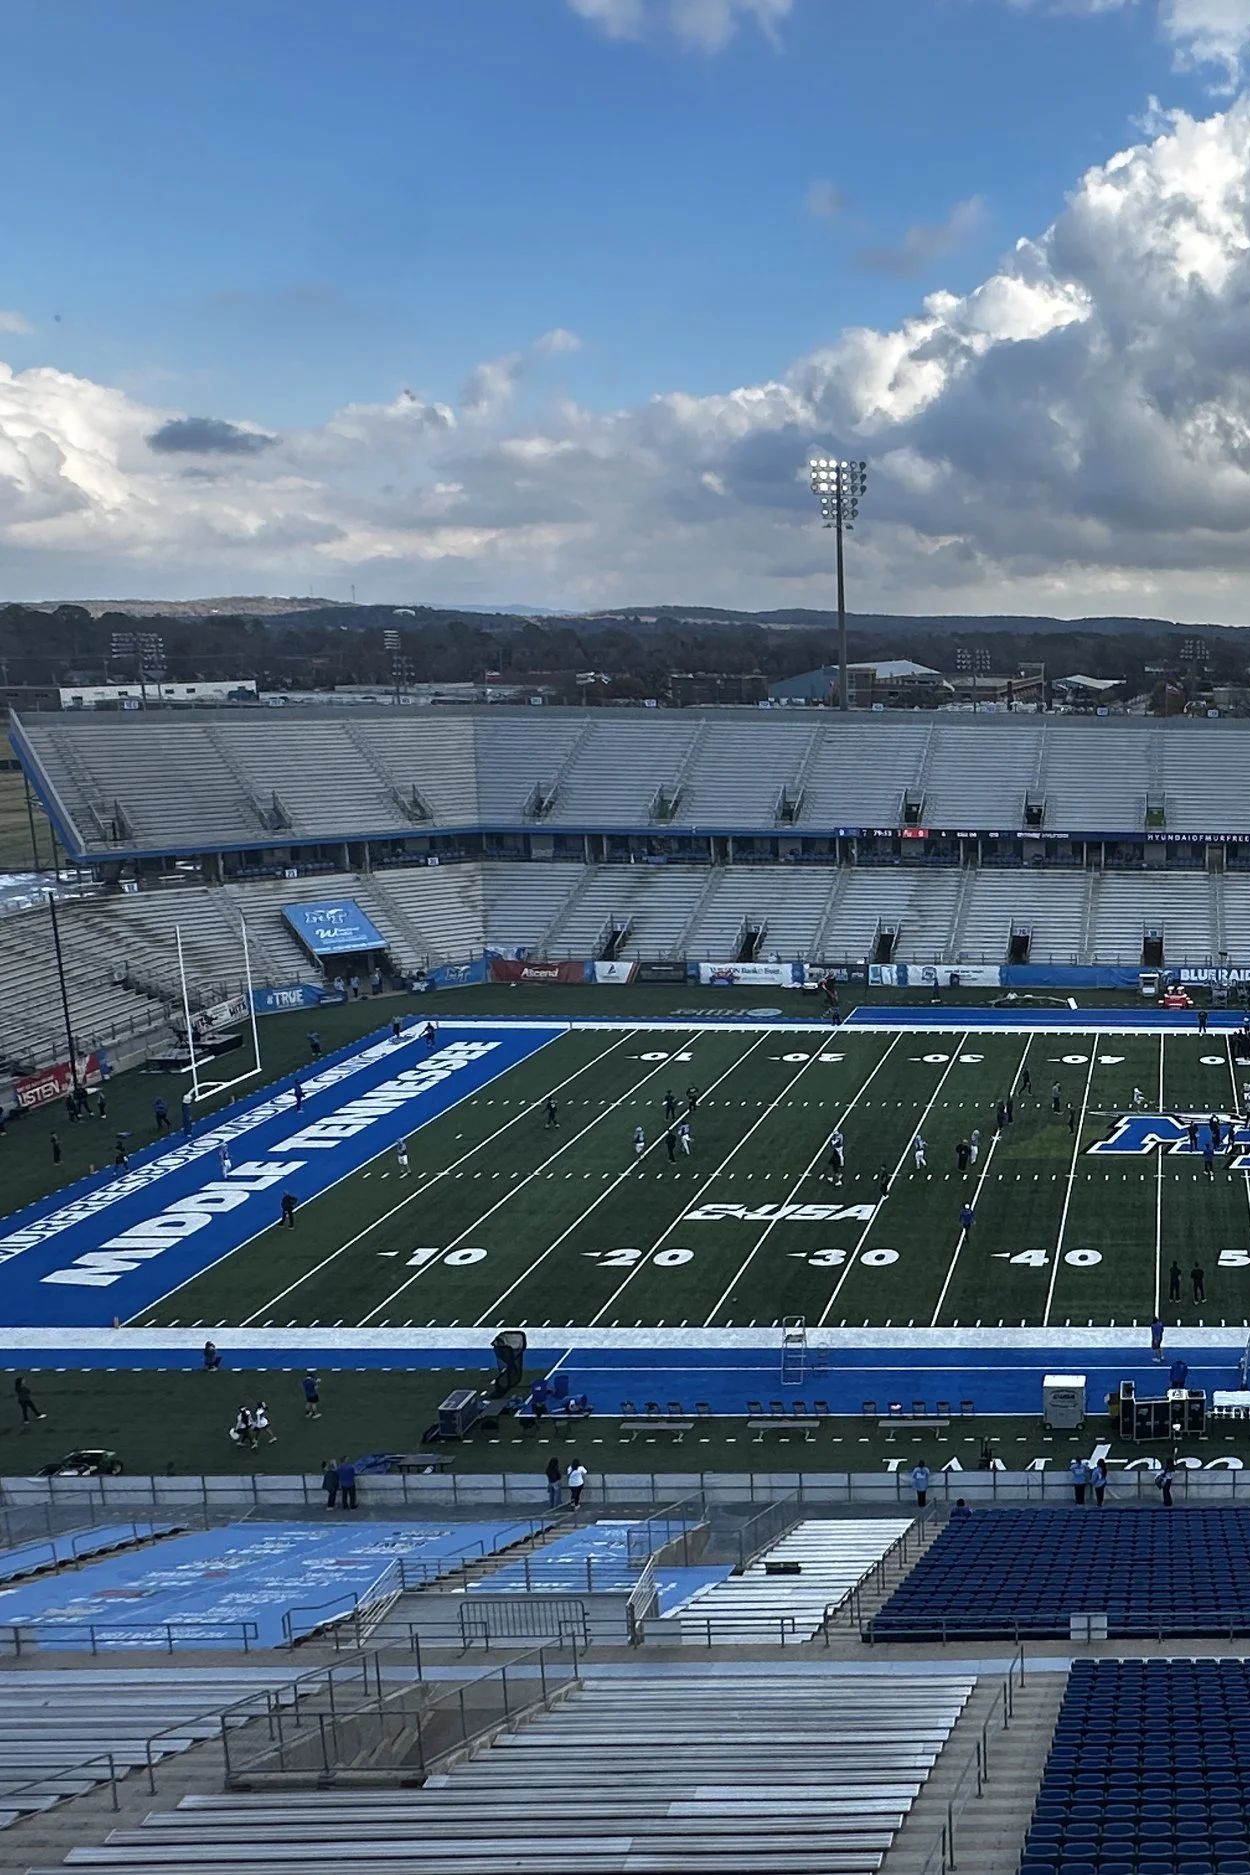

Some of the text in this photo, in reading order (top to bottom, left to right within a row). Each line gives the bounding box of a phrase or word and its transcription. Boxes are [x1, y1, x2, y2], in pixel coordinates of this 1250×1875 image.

[521, 967, 560, 978] Ascend
[1180, 969, 1216, 981] BLUE
[782, 1052, 846, 1063] 20
[922, 1053, 985, 1064] 30
[1062, 1054, 1126, 1064] 40
[40, 1041, 503, 1287] MIDDLE TENNESSEE
[405, 1247, 488, 1266] 10
[596, 1247, 695, 1266] 20
[808, 1248, 900, 1266] 30
[1009, 1249, 1103, 1267] 40
